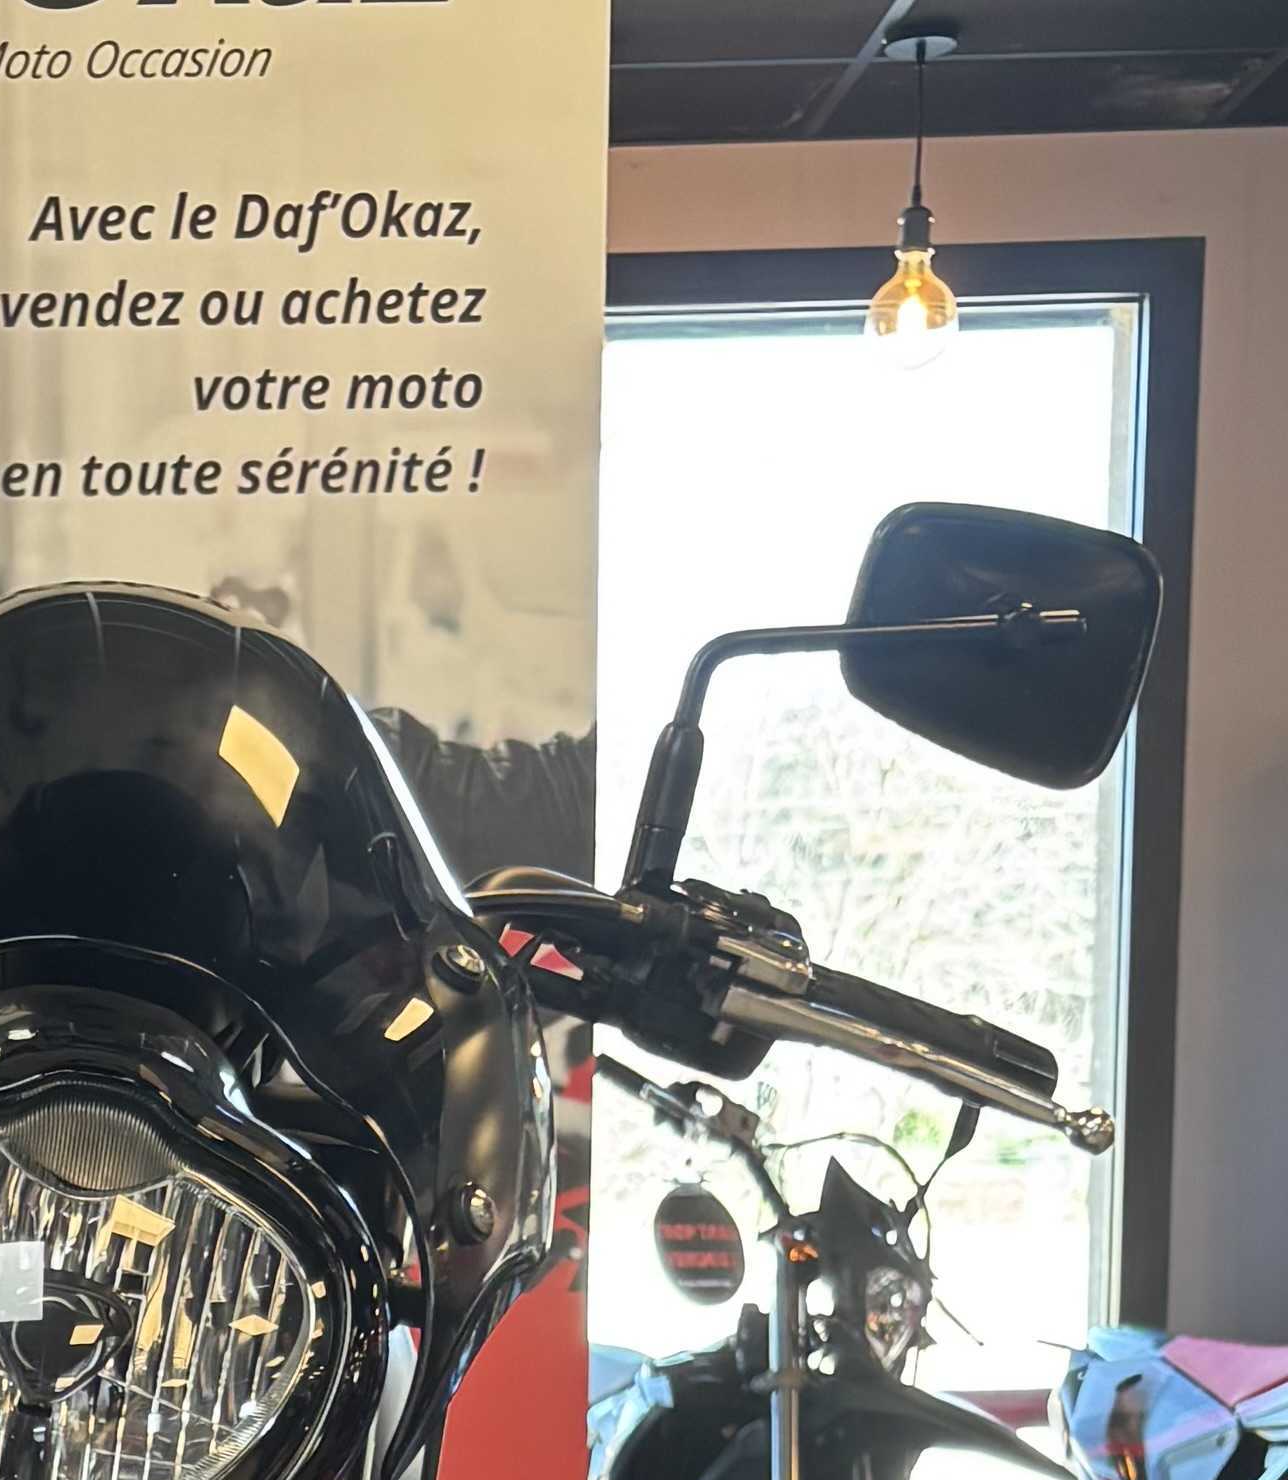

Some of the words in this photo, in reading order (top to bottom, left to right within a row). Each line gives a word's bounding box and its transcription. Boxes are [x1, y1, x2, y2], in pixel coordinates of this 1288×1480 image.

[85, 38, 273, 79] Occasion
[28, 195, 157, 242] Avec
[170, 191, 218, 240] le
[0, 278, 186, 328] vendez
[199, 289, 265, 327] ou
[280, 276, 487, 326] achetez
[193, 367, 331, 412] votre
[345, 366, 484, 411] moto
[0, 461, 63, 498] en
[80, 453, 223, 497] toute
[237, 444, 454, 496] sérénité
